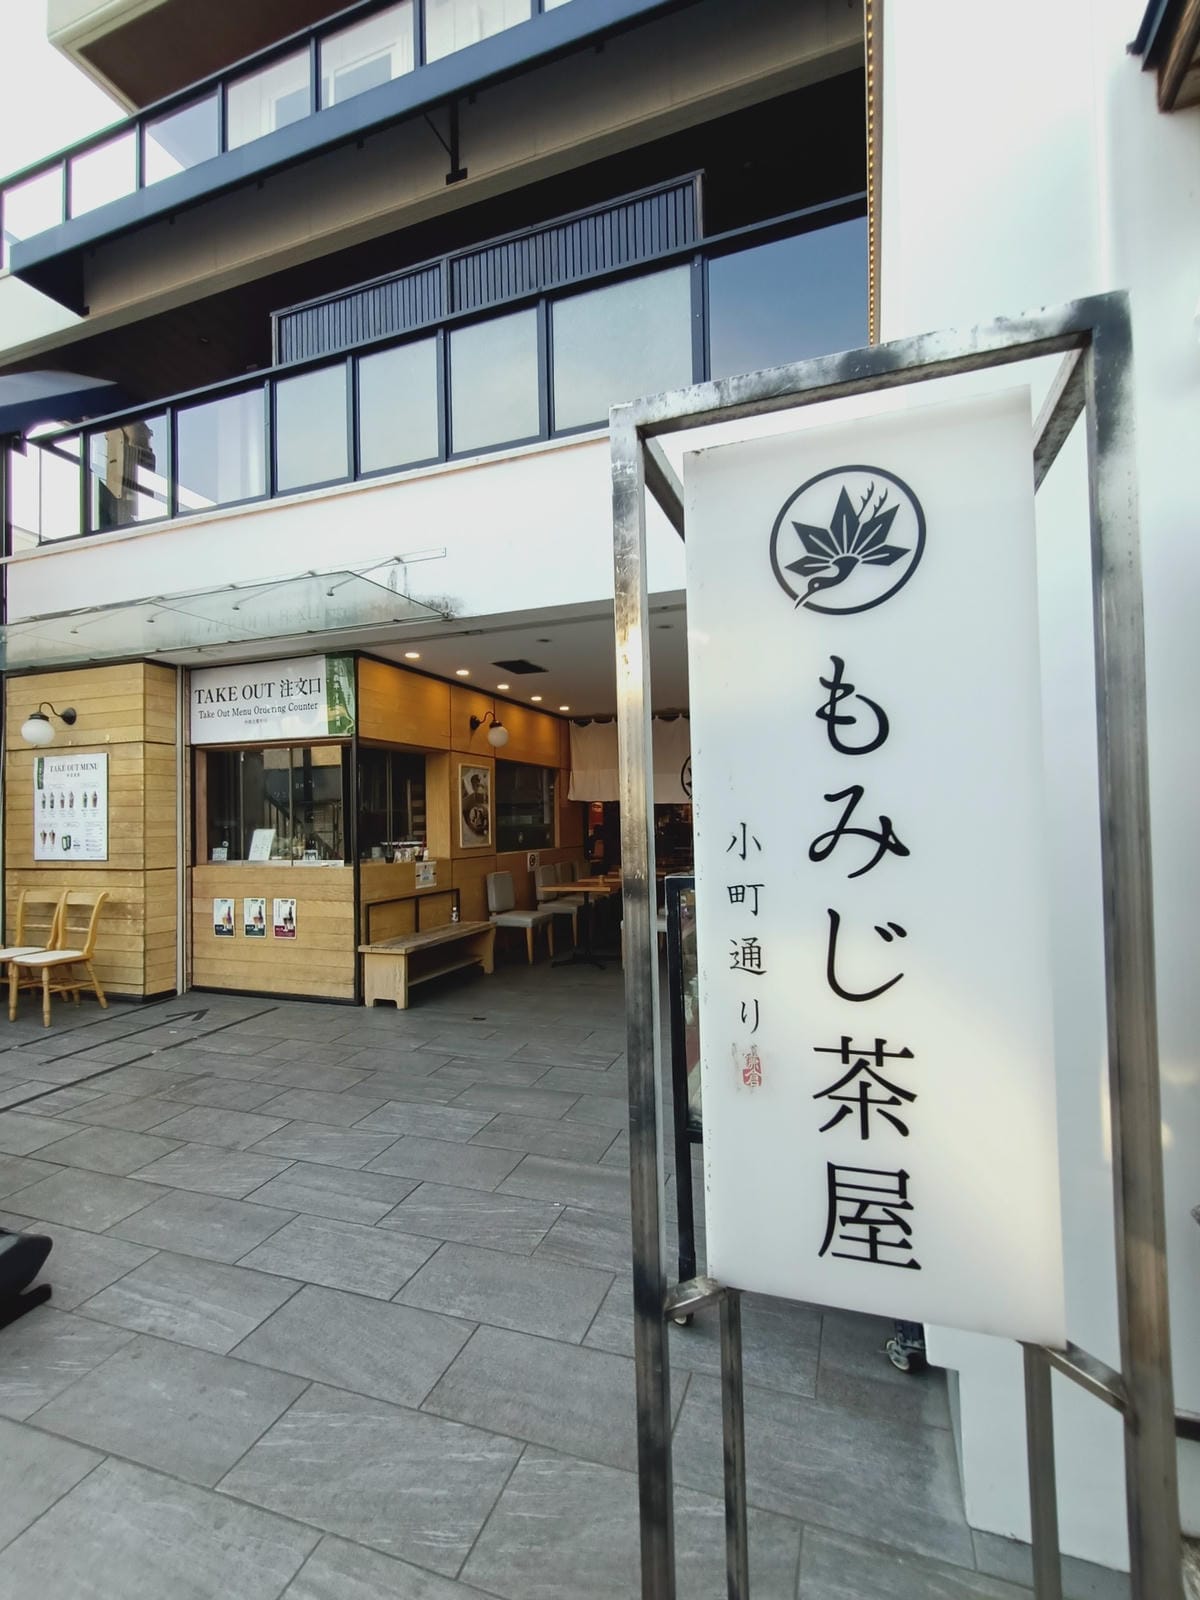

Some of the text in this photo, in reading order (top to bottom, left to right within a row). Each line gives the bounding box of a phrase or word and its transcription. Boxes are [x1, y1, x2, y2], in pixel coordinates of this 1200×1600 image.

[195, 677, 321, 704] TAKE OUT 注文口
[199, 702, 318, 719] Take Out Menu Ordering Counter
[50, 765, 65, 773] TAKE
[67, 764, 79, 772] OUT
[726, 821, 767, 1035] 小町通り
[808, 655, 922, 1272] もみじ茶屋
